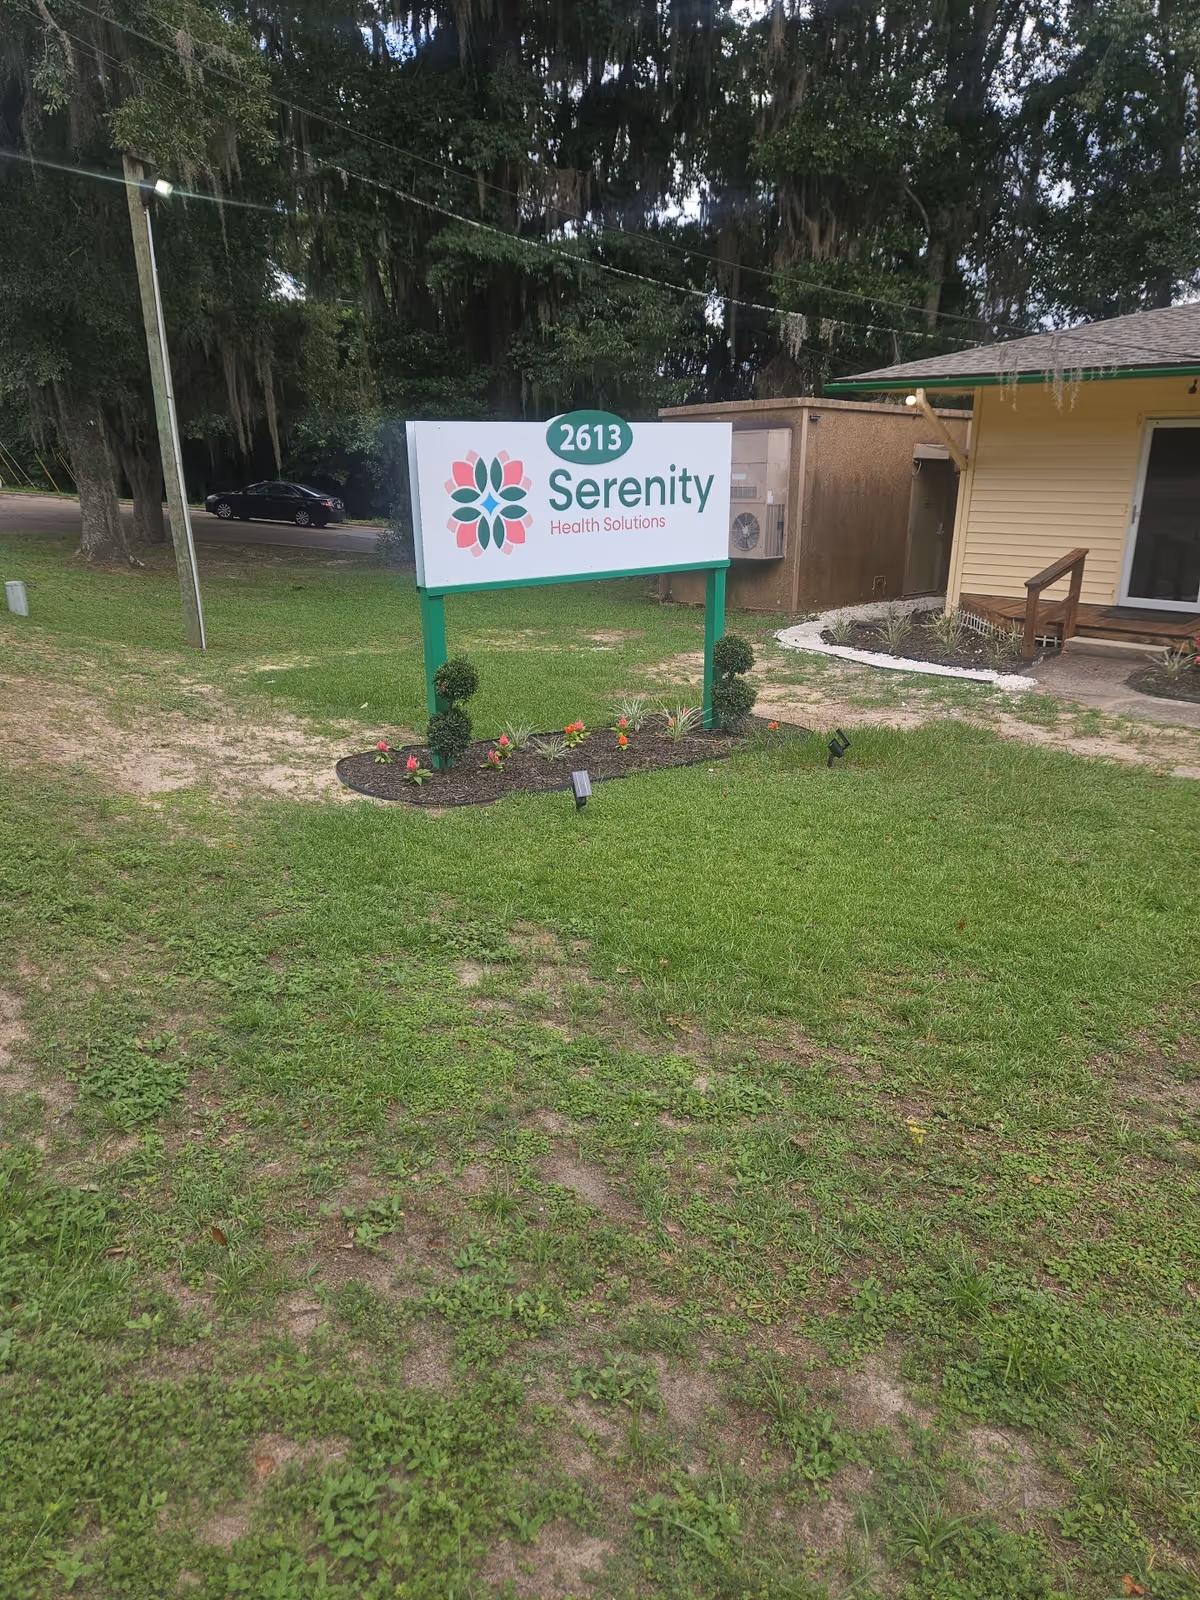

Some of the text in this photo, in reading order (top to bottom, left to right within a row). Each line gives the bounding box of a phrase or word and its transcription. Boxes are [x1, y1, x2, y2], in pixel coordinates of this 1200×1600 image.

[559, 423, 622, 451] 2613
[549, 463, 715, 513] Serenity
[550, 514, 666, 535] Health Solutions
